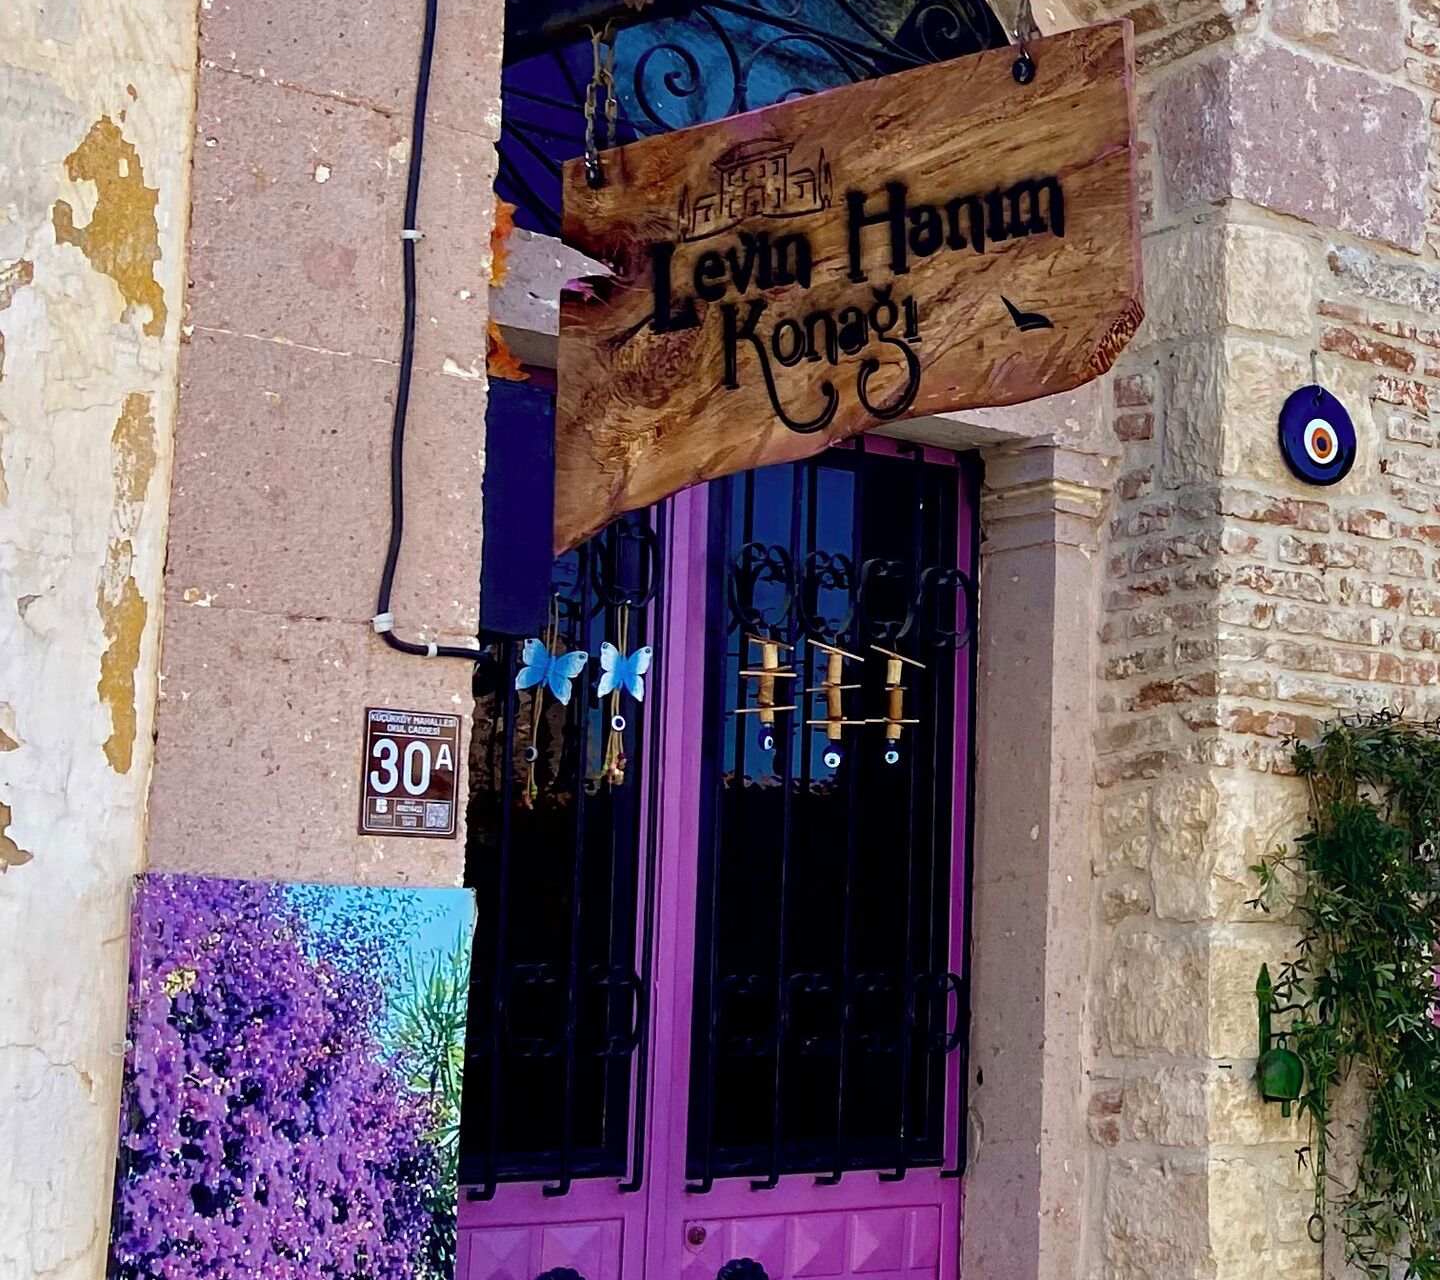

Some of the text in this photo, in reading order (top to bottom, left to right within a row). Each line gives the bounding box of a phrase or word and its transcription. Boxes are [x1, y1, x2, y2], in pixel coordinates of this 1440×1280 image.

[846, 175, 1065, 284] Hanım
[720, 283, 923, 434] Konağı
[387, 724, 406, 734] OKUL
